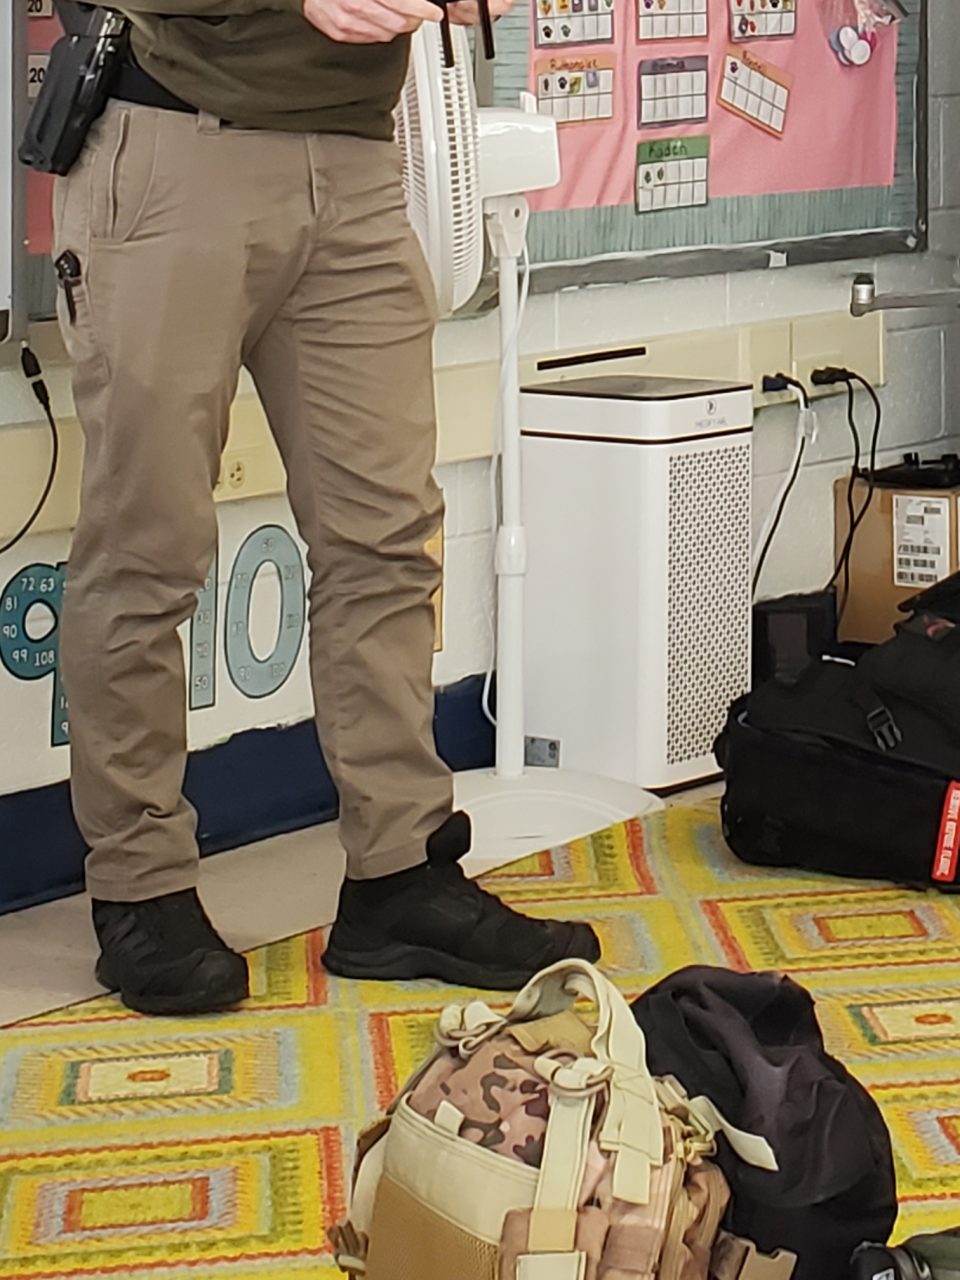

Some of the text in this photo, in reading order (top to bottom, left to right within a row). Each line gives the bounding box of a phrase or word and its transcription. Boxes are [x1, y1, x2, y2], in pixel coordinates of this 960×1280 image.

[21, 577, 36, 592] 72
[39, 578, 55, 593] 63
[5, 595, 18, 611] 81
[2, 624, 18, 638] 90
[12, 647, 28, 663] 99
[34, 648, 55, 667] 108
